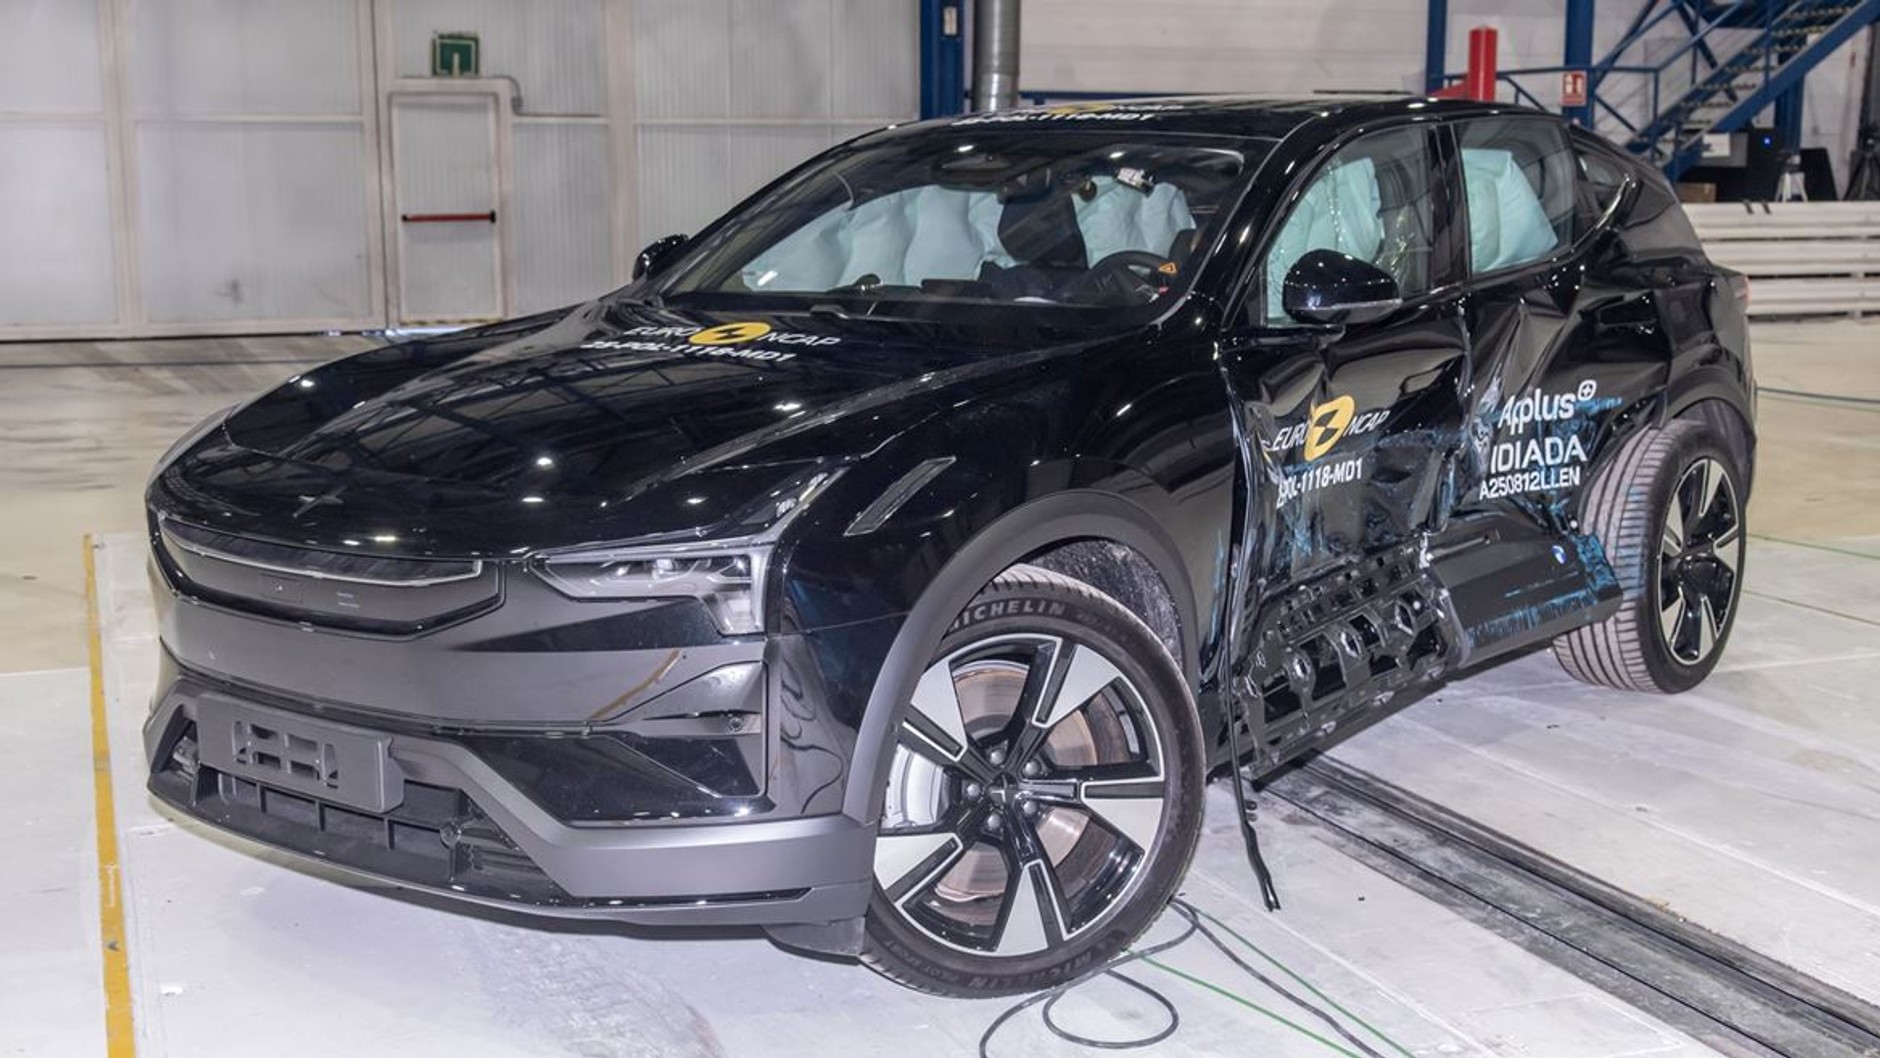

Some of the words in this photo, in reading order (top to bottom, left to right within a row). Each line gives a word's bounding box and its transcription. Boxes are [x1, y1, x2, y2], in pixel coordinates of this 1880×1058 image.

[623, 326, 703, 338] EURO
[757, 331, 842, 346] NCAP
[1342, 409, 1391, 438] NCAP
[1490, 434, 1588, 475] IDIADA
[1479, 465, 1581, 501] A250812LLEN
